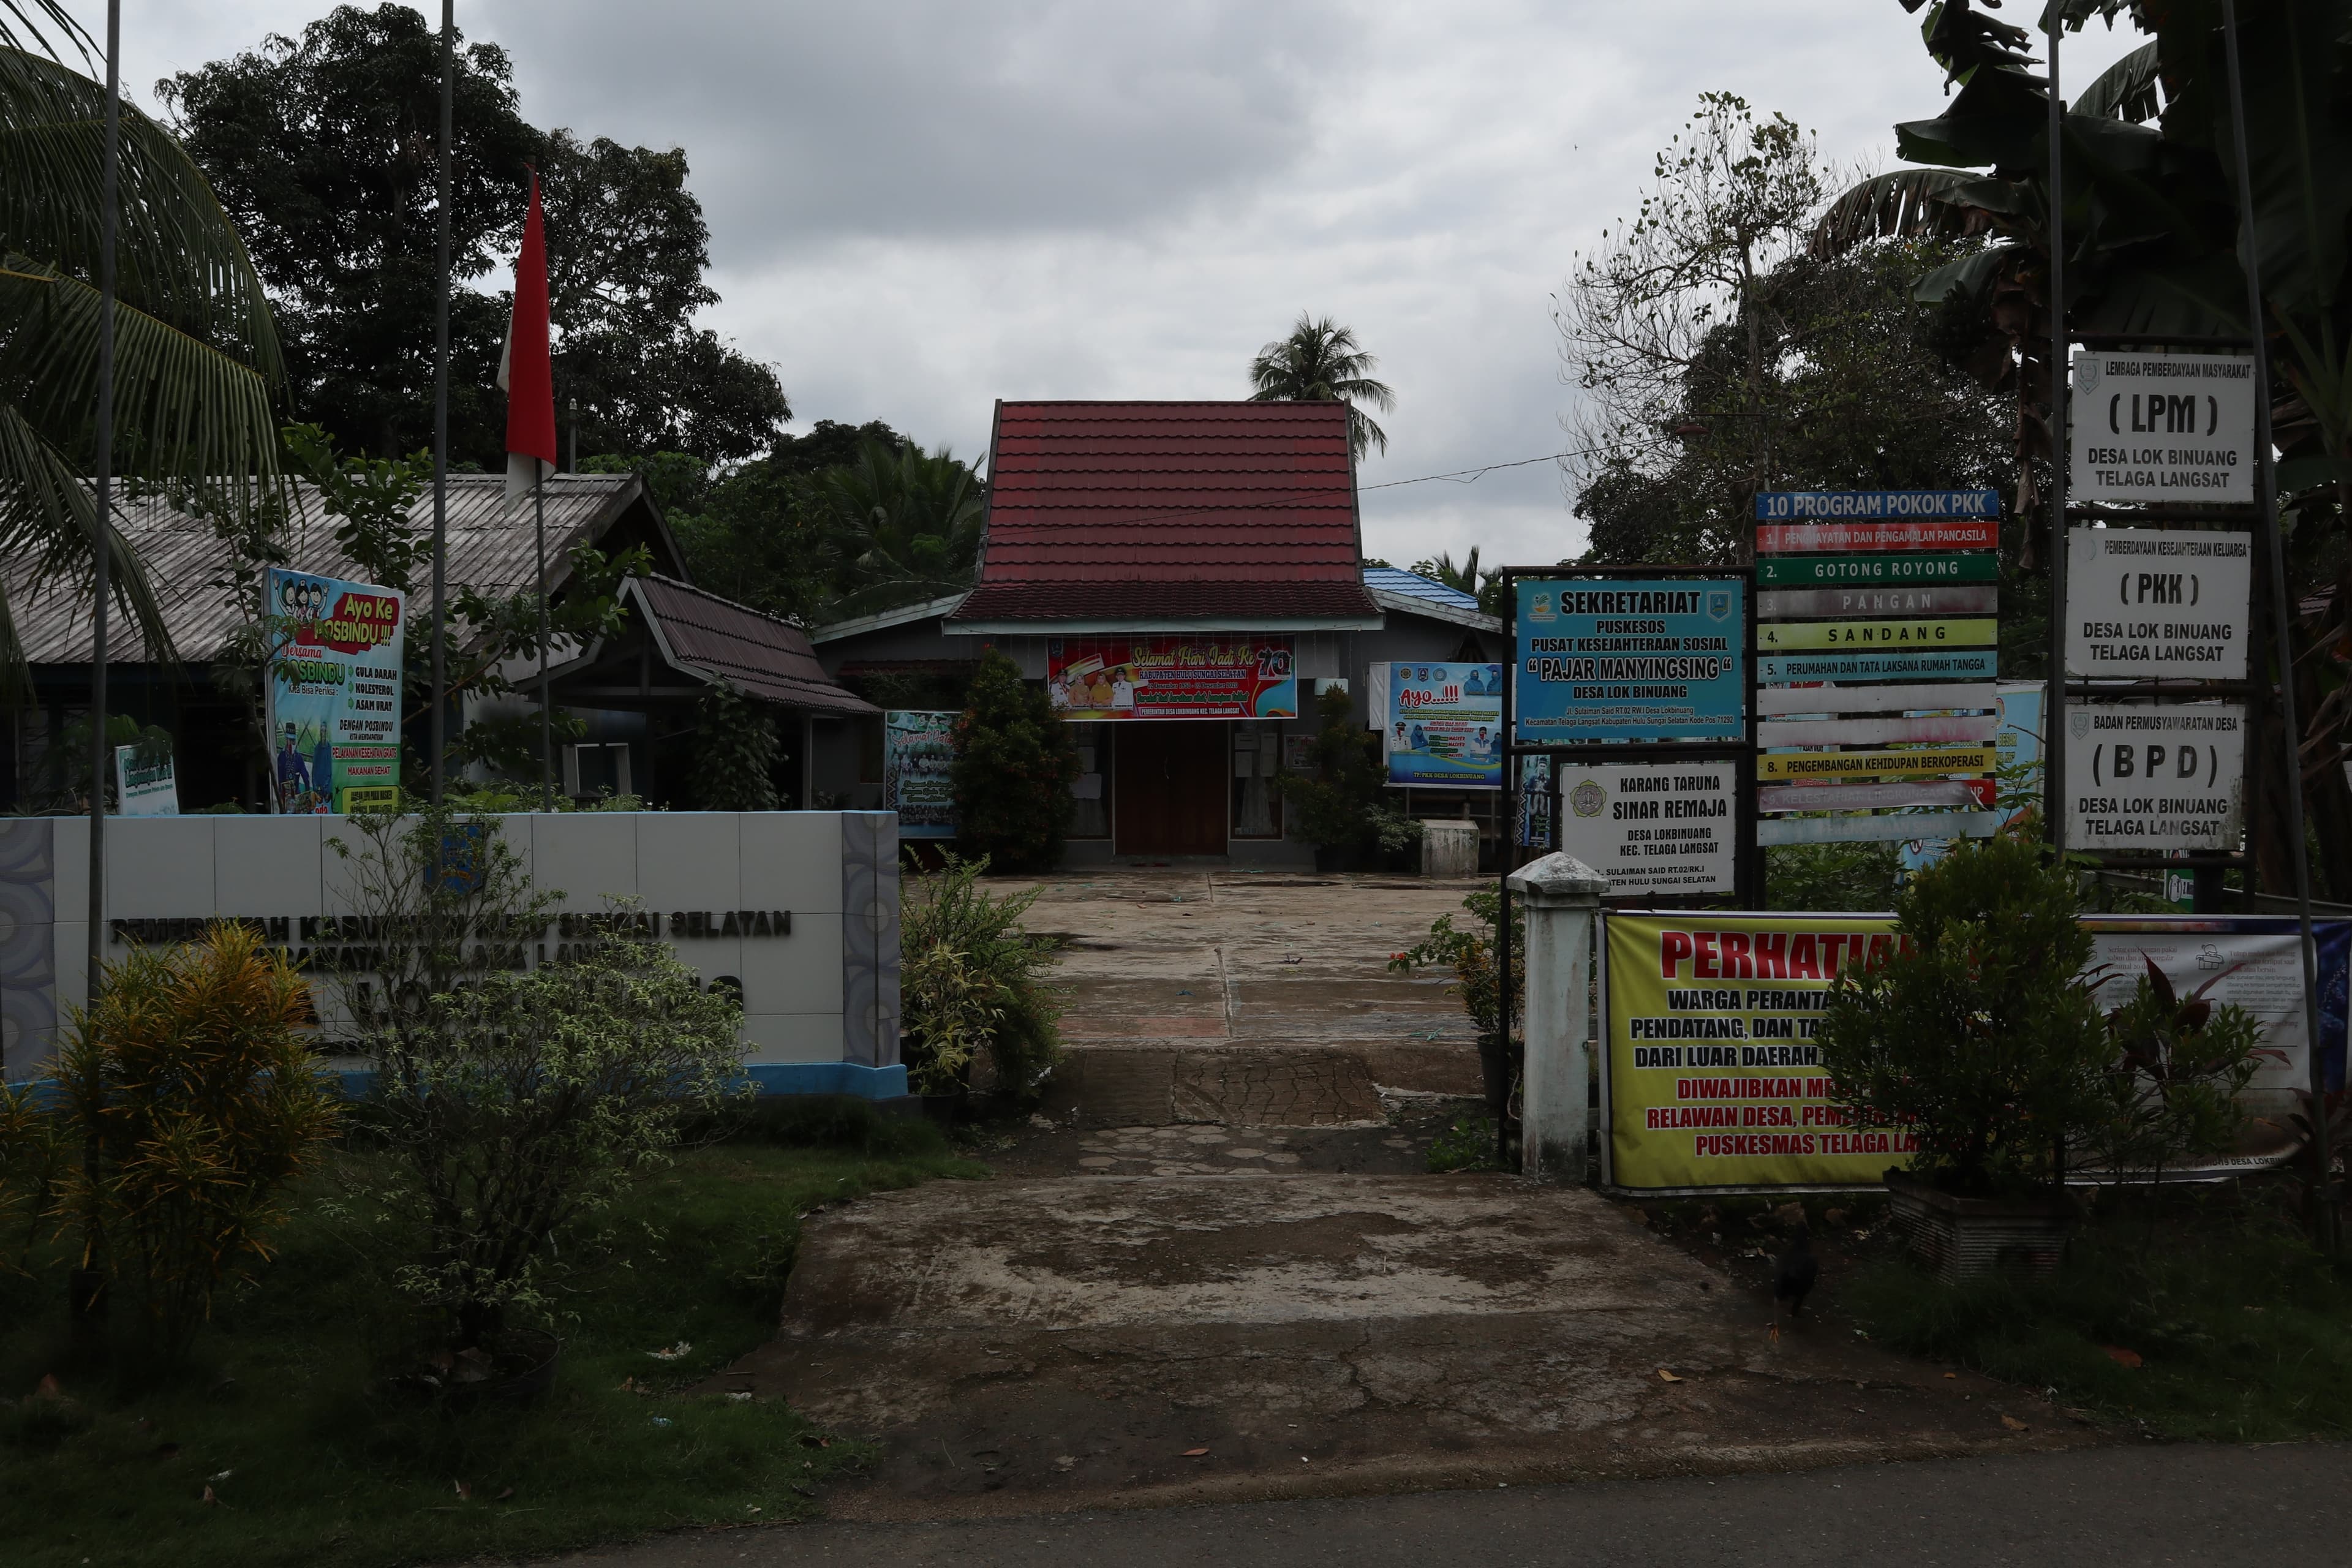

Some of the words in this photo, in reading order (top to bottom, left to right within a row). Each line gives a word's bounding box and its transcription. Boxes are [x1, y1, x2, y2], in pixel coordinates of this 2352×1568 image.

[2106, 361, 2141, 376] LEMBAGA
[2143, 362, 2201, 377] PEMBERDAYAAN
[2203, 364, 2251, 379] MASYARAKAT
[2089, 448, 2128, 464] DESA
[2133, 449, 2163, 464] LOK
[2168, 450, 2237, 466] BINUANG
[2096, 470, 2155, 486] TELAGA
[2160, 471, 2230, 488] LANGSAT
[1766, 496, 1788, 516] 10
[1793, 495, 1881, 516] PROGRAM
[1887, 494, 1947, 514] POKOK
[1951, 494, 1986, 513] PKK
[1785, 531, 1851, 545] PENGHAYATAN
[1853, 532, 1872, 543] DAN
[1875, 530, 1935, 543] PENGAMALAN
[1937, 529, 1986, 541] PANCASILA
[2105, 540, 2156, 555] PEMBERDAYAAN
[2158, 541, 2211, 556] KESEJAHTERAAN
[2213, 543, 2247, 557] KELUARGA
[1766, 565, 1777, 578] 2.
[1814, 562, 1882, 577] GOTONG
[1891, 561, 1958, 576] ROYONG
[344, 594, 372, 623] Ayo
[375, 598, 393, 620] Ke
[1561, 591, 1701, 614] SEKRETARIAT
[1766, 598, 1777, 611] 3.
[1842, 594, 1931, 609] PANGAN
[1596, 620, 1666, 634] PUSKESOS
[1767, 630, 1778, 643] 4.
[1828, 626, 1945, 641] SANDANG
[2083, 622, 2124, 638] DESA
[2128, 623, 2158, 639] LOK
[2164, 624, 2232, 639] BINUANG
[1532, 638, 1574, 652] PUSAT
[1577, 637, 1680, 652] KESEJAHTERAAN
[1683, 637, 1728, 651] SOSIAL
[2090, 644, 2150, 660] TELAGA
[2155, 646, 2224, 662] LANGSAT
[1133, 646, 1177, 667] Selamat
[1178, 646, 1207, 667] Hari
[1208, 646, 1236, 667] Jadi
[355, 666, 372, 679] GULA
[374, 667, 398, 680] DARAH
[1139, 671, 1175, 679] KABUPATEN
[1176, 670, 1192, 679] HULU
[1194, 670, 1216, 679] SUNGAI
[1218, 669, 1246, 678] SELATAN
[1540, 657, 1596, 682] PAJAR
[1599, 657, 1719, 680] MANYINGSING
[1767, 663, 1777, 676] 5.
[1786, 662, 1838, 675] PERUMAHAN
[1840, 662, 1858, 673] DAN
[1860, 661, 1880, 673] TATA
[1882, 660, 1918, 673] LAKSANA
[1921, 660, 1951, 672] RUMAH
[1952, 658, 1985, 671] TANGGA
[355, 683, 394, 696] KOLESTEROL
[1573, 686, 1604, 699] DESA
[1607, 685, 1630, 699] LOK
[1632, 685, 1687, 699] BINUANG
[355, 699, 374, 711] ASAM
[376, 700, 393, 712] URAT
[1574, 707, 1600, 715] Sulaiman
[1615, 706, 1631, 715] RT.02
[1646, 706, 1660, 715] Desa
[1661, 706, 1694, 715] Lokbinuang
[339, 719, 364, 731] DENGAN
[365, 720, 393, 732] POSBINDU
[1525, 718, 1557, 726] Kecamatan
[1558, 718, 1577, 728] Telaga
[1578, 718, 1600, 727] Langsat
[1601, 717, 1632, 726] Kabupaten
[1647, 717, 1667, 726] Sungai
[1705, 716, 1716, 725] Pos
[2094, 715, 2124, 729] BADAN
[2125, 716, 2213, 731] PERMUSYAWARATAN
[2215, 717, 2237, 731] DESA
[1998, 733, 2018, 747] BESAR
[347, 766, 374, 775] MAKANAN
[375, 766, 391, 775] SEHAT
[1767, 762, 1777, 773] 8.
[1787, 759, 1863, 773] PENGEMBANGAN
[1865, 757, 1918, 771] KEHIDUPAN
[1921, 755, 1985, 769] BERKOPERASI
[1620, 777, 1670, 793] KARANG
[1673, 775, 1721, 791] TARUNA
[1613, 801, 1659, 820] SINAR
[1665, 799, 1727, 819] REMAJA
[2079, 797, 2118, 813] DESA
[2123, 798, 2154, 814] LOK
[2158, 798, 2227, 815] BINUANG
[1627, 829, 1651, 842] DESA
[1654, 827, 1711, 840] LOKBINUANG
[2086, 820, 2145, 835] TELAGA
[2149, 820, 2220, 835] LANGSAT
[1620, 845, 1640, 856] KEC.
[1644, 843, 1677, 856] TELAGA
[1679, 842, 1719, 854] LANGSAT
[1606, 867, 1646, 876] SULAIMAN
[671, 910, 792, 937] SELATAN
[1668, 990, 1743, 1011] WARGA
[1630, 1018, 1749, 1041] PENDATANG,
[1752, 1017, 1793, 1039] DAN
[1635, 1047, 1683, 1068] DARI
[1686, 1047, 1737, 1068] LUAR
[1742, 1046, 1818, 1068] DAERAH
[1676, 1077, 1802, 1100] DIWAJIBKAN
[1646, 1106, 1738, 1130] RELAWAN
[1743, 1106, 1797, 1128] DESA,
[1695, 1134, 1815, 1156] PUSKESMAS
[1819, 1134, 1888, 1155] TELAGA
[2231, 1158, 2252, 1166] DESA
